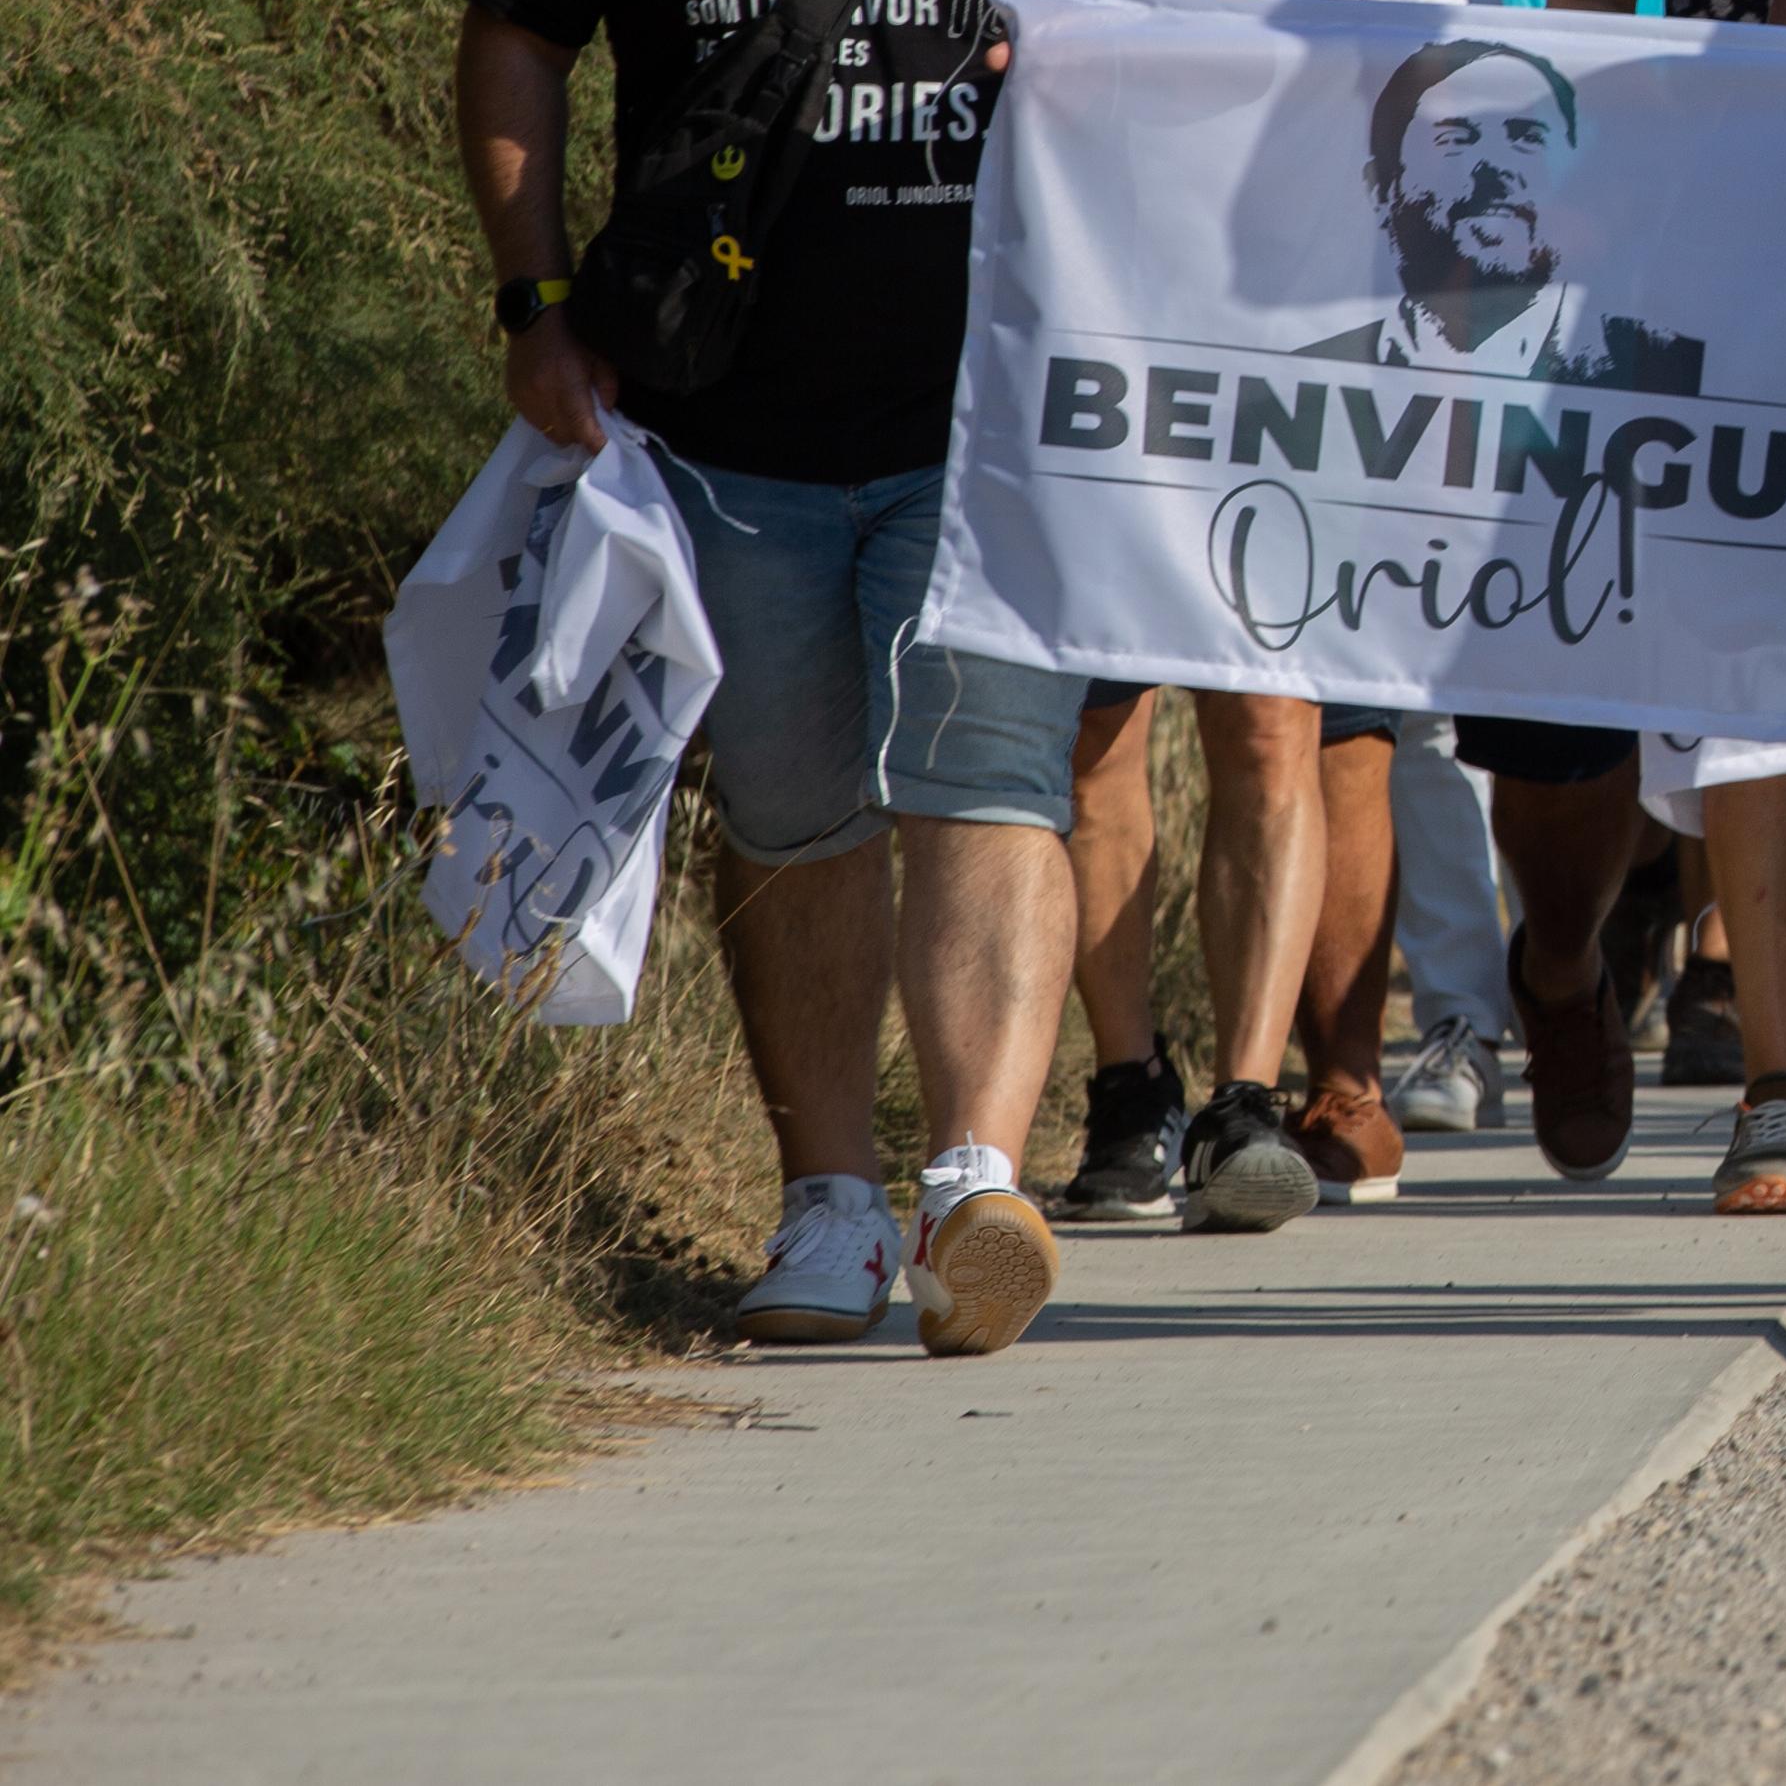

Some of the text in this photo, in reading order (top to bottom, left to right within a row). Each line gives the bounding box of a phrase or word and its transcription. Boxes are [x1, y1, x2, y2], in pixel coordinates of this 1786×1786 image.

[845, 182, 975, 206] ORIOL JUNQUERA
[1207, 468, 1636, 653] Oriol!
